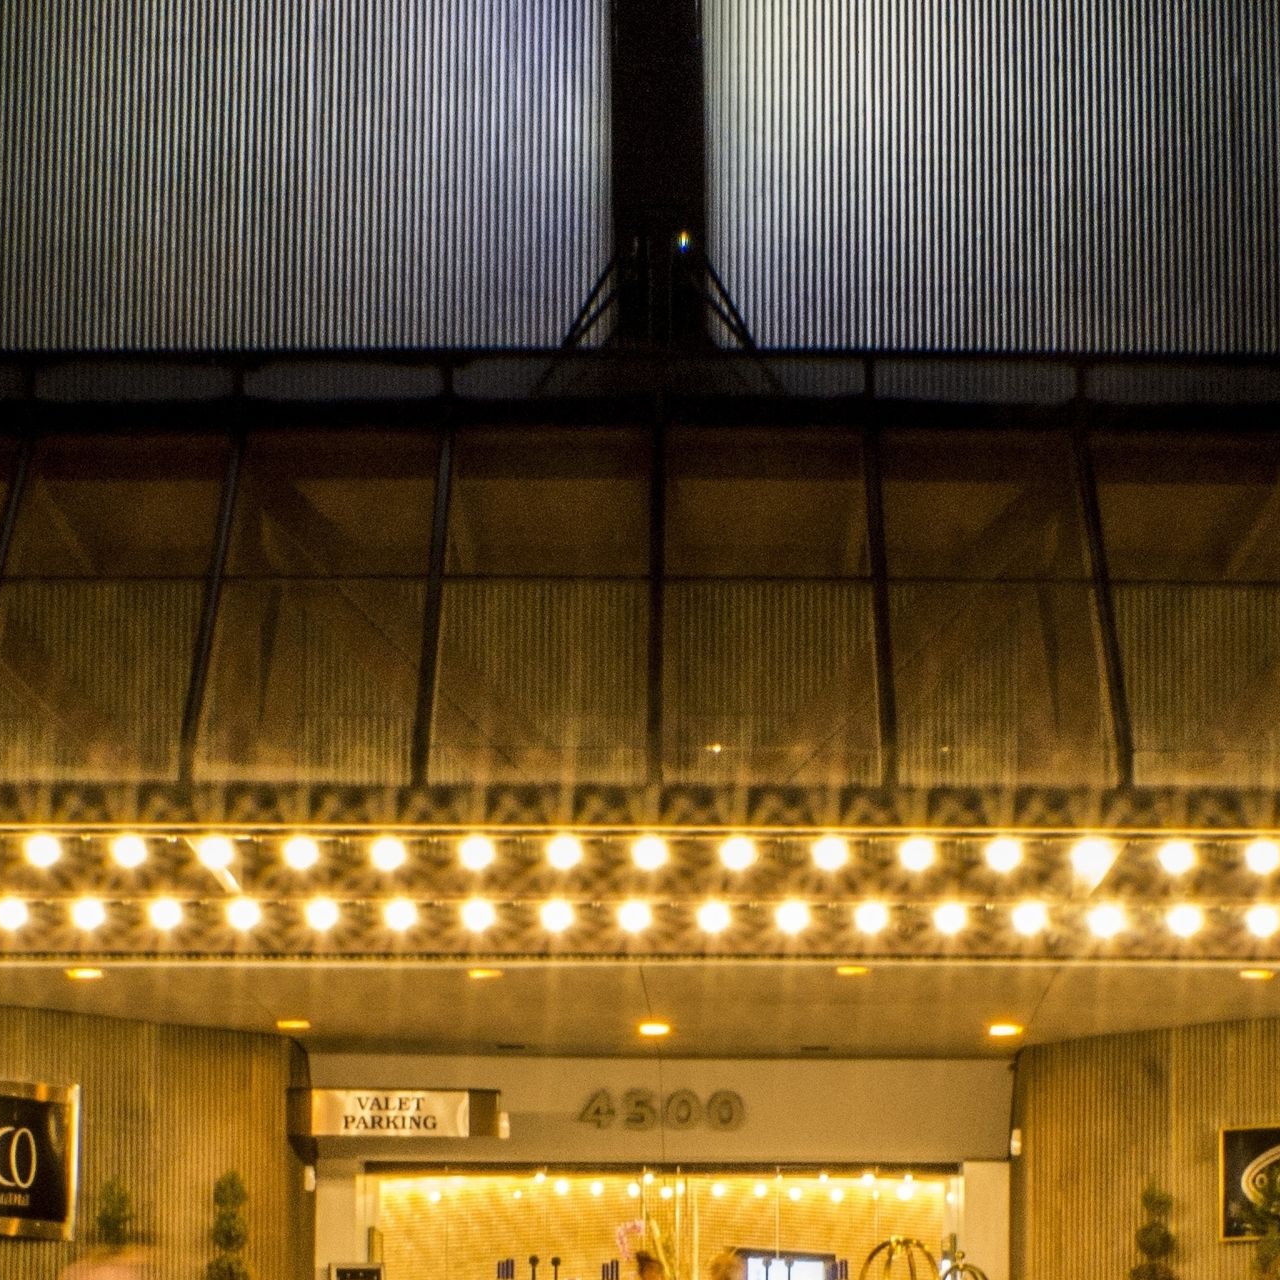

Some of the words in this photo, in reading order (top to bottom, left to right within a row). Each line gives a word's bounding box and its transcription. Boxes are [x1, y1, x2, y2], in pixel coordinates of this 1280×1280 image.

[356, 1096, 424, 1111] VALET
[577, 1087, 746, 1131] 4500
[344, 1115, 437, 1130] PARKING
